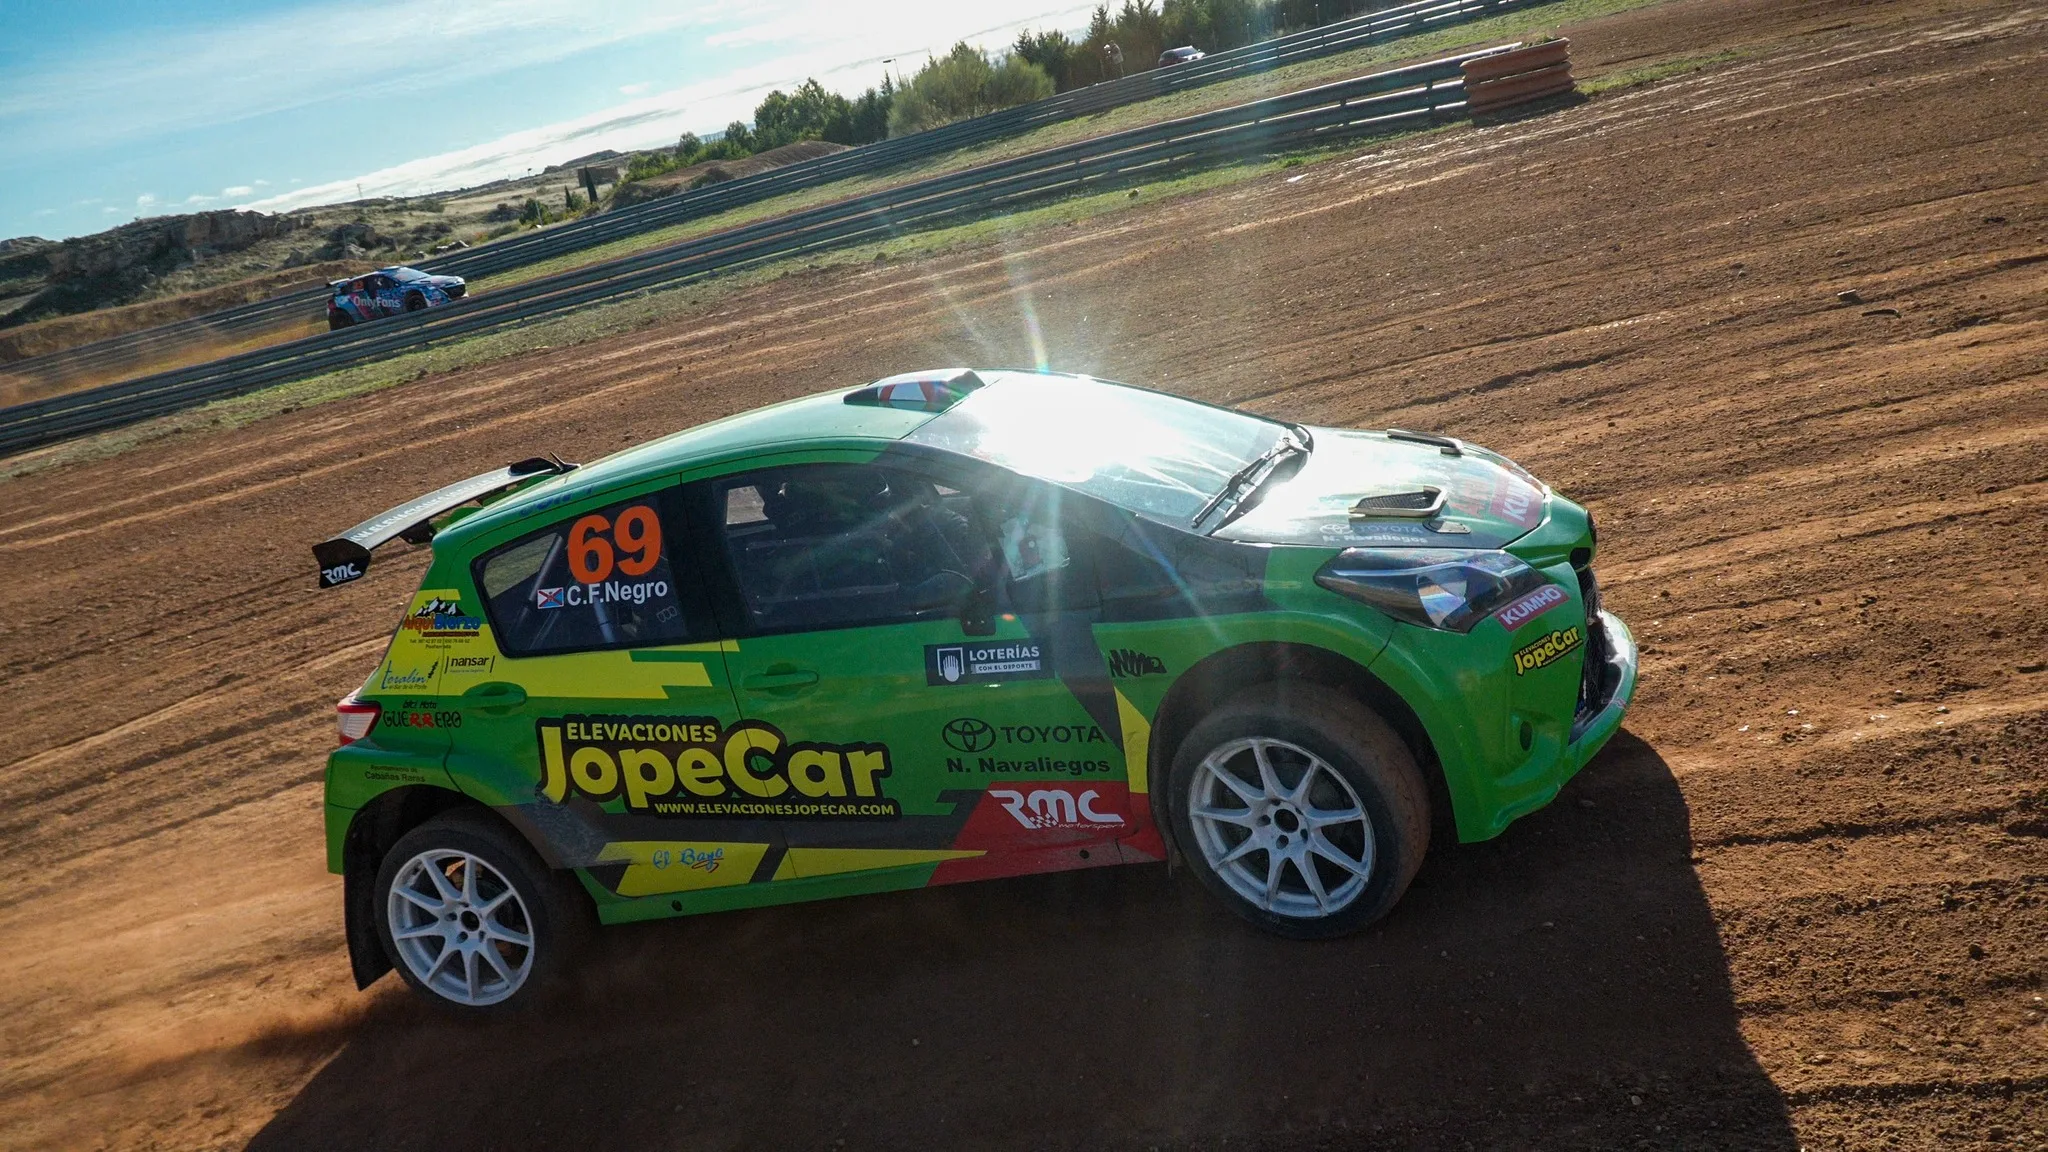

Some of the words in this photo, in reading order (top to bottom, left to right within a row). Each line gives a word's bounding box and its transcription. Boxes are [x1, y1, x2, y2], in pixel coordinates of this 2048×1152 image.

[353, 296, 400, 308] OnlyFans
[1344, 535, 1429, 543] Navaliegos
[1359, 525, 1424, 534] TOYOTA
[567, 505, 662, 585] 69
[566, 580, 668, 606] C.F.Negro
[1500, 588, 1562, 625] KUMHO
[969, 645, 1040, 662] LOTERÍAS
[1514, 627, 1579, 675] JopeCar
[450, 657, 490, 667] nansar
[383, 711, 462, 728] GUERRERO
[567, 723, 717, 743] ELEVACIONES
[1000, 725, 1105, 744] TOYOTA
[541, 726, 885, 808] JopeCar
[946, 757, 971, 773] N.
[979, 757, 1110, 776] Navaliegos
[654, 803, 895, 816] WWW.ELEVACIONESJOPECAR.COM
[988, 790, 1124, 829] RMC
[1058, 821, 1127, 831] motorsport
